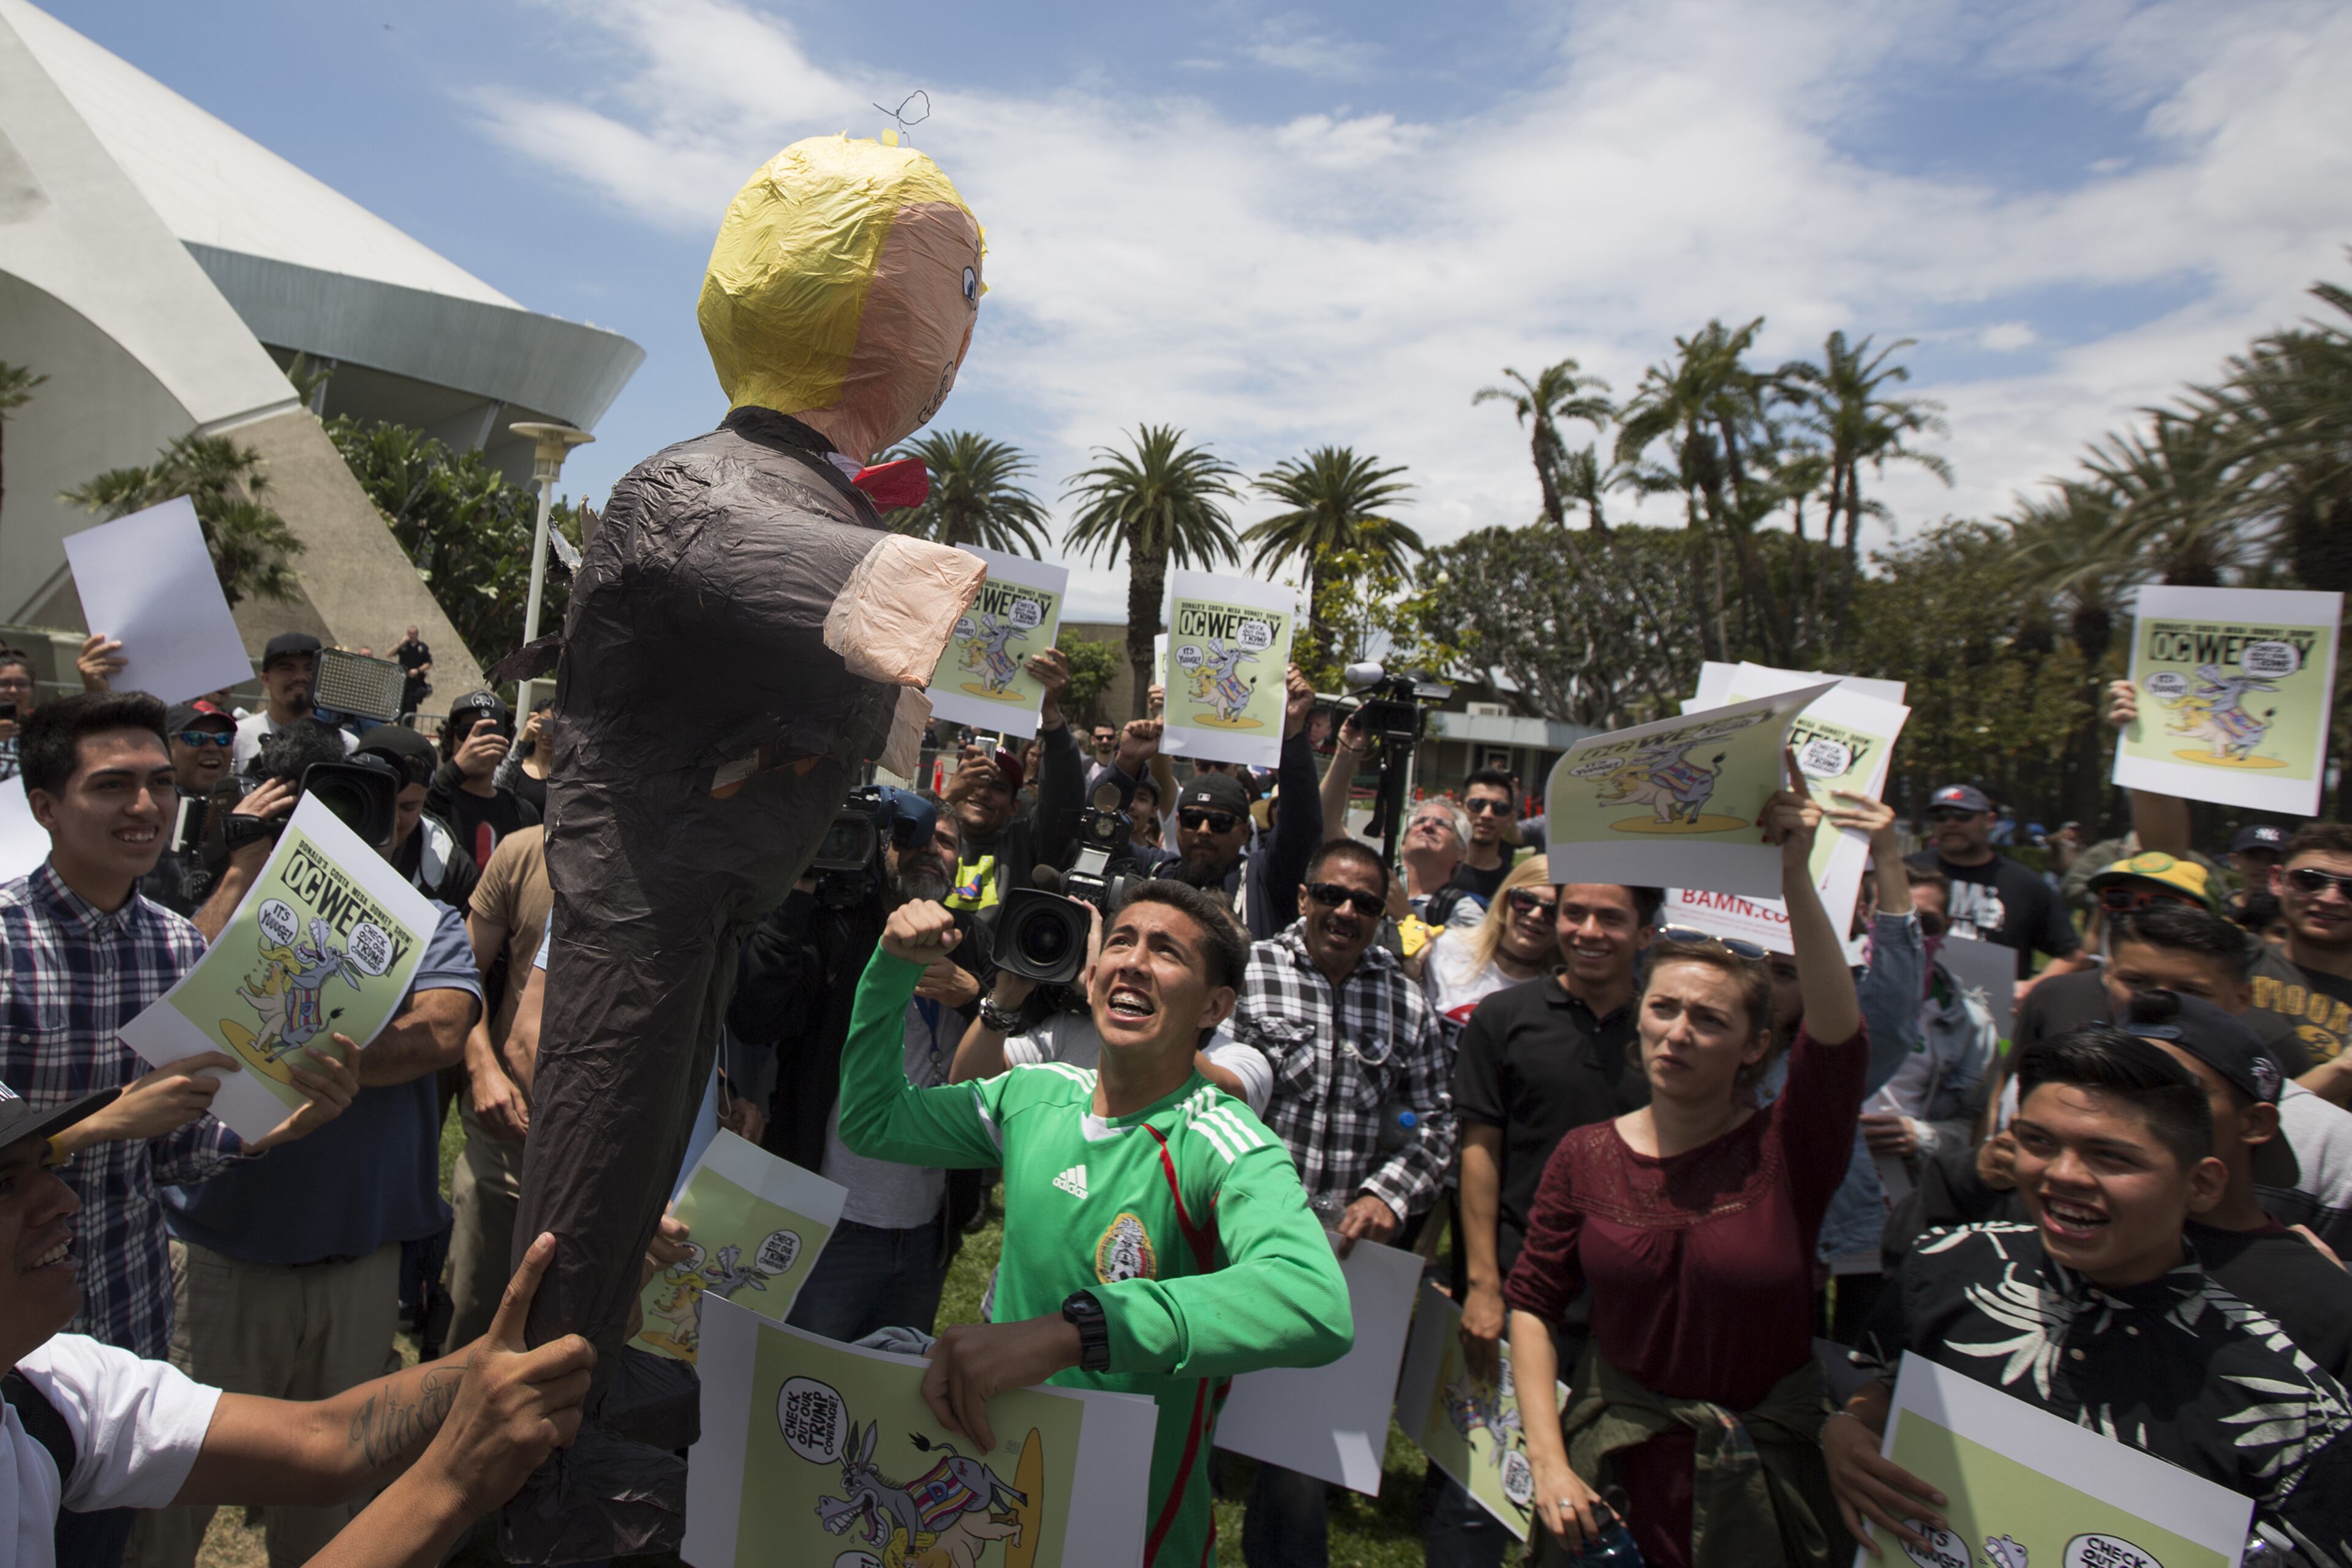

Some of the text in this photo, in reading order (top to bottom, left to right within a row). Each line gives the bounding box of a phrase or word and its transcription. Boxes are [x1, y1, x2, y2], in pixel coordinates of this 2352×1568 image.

[298, 839, 414, 946] DONALD'S COSTA MESA DONKEY SHOW!
[260, 909, 294, 944] YUUUGE!
[274, 903, 291, 922] IT'S
[356, 935, 385, 967] TRUMP
[358, 930, 386, 957] OUT OUR
[363, 924, 387, 947] CHECK
[350, 944, 382, 974] COVERAGE!
[1052, 1177, 1088, 1200] adidas
[772, 1232, 796, 1246] CHECK
[765, 1247, 792, 1265] TRUMP
[784, 1390, 801, 1439] CHECK
[797, 1391, 813, 1445] OUT OUR
[808, 1391, 829, 1449] TRUMP
[824, 1394, 839, 1456] COVERAGE!
[2087, 1537, 2147, 1568] CHECK
